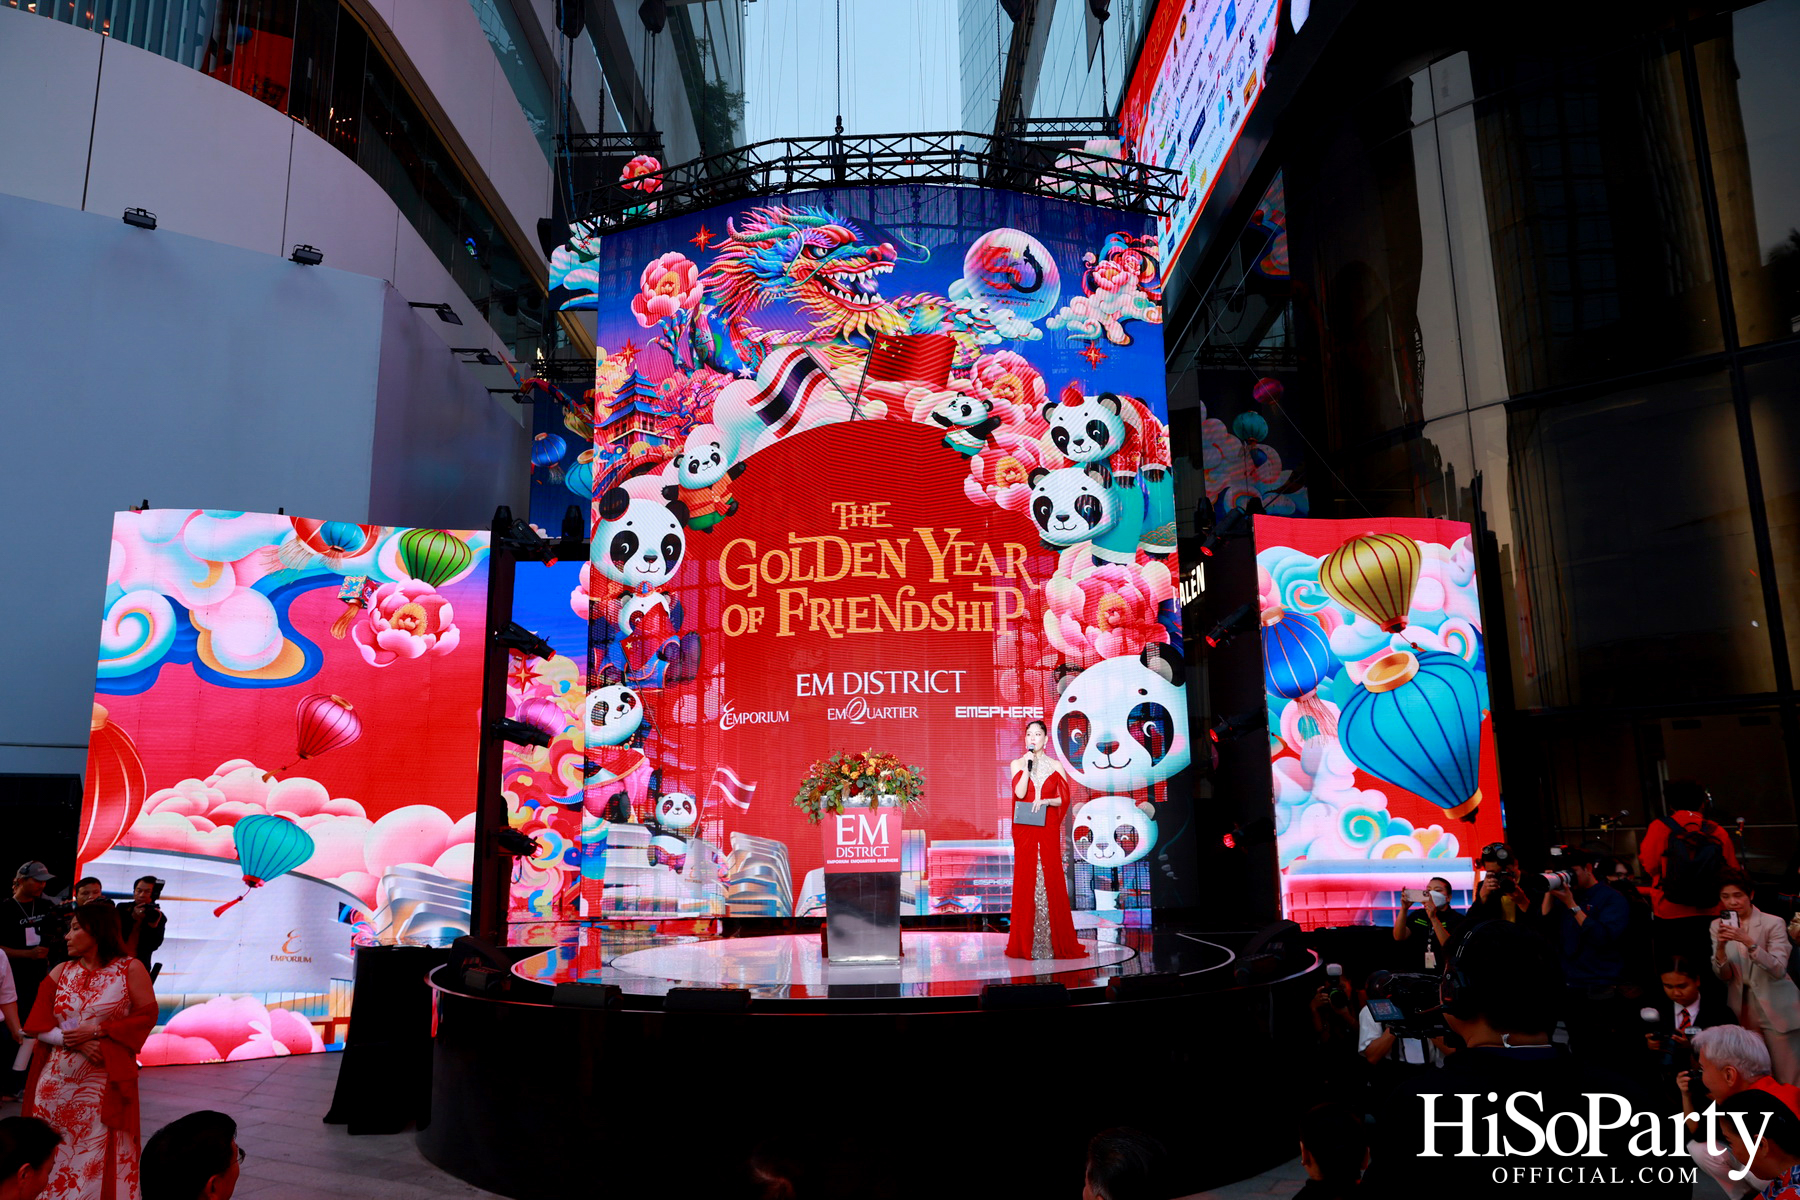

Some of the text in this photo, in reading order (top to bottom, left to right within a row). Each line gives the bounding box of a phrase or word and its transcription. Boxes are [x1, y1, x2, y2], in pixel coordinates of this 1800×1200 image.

[832, 501, 893, 530] THE
[718, 527, 1042, 598] GOLDEN YEAR
[721, 582, 1026, 639] OF FRIENDSHIP
[796, 669, 967, 697] EM DISTRICT
[827, 696, 919, 725] EMQUARTIER
[955, 706, 1044, 719] EMSPHERE
[835, 813, 890, 846] EM
[836, 845, 890, 858] DISTRICT
[270, 954, 312, 963] EMPORIUM
